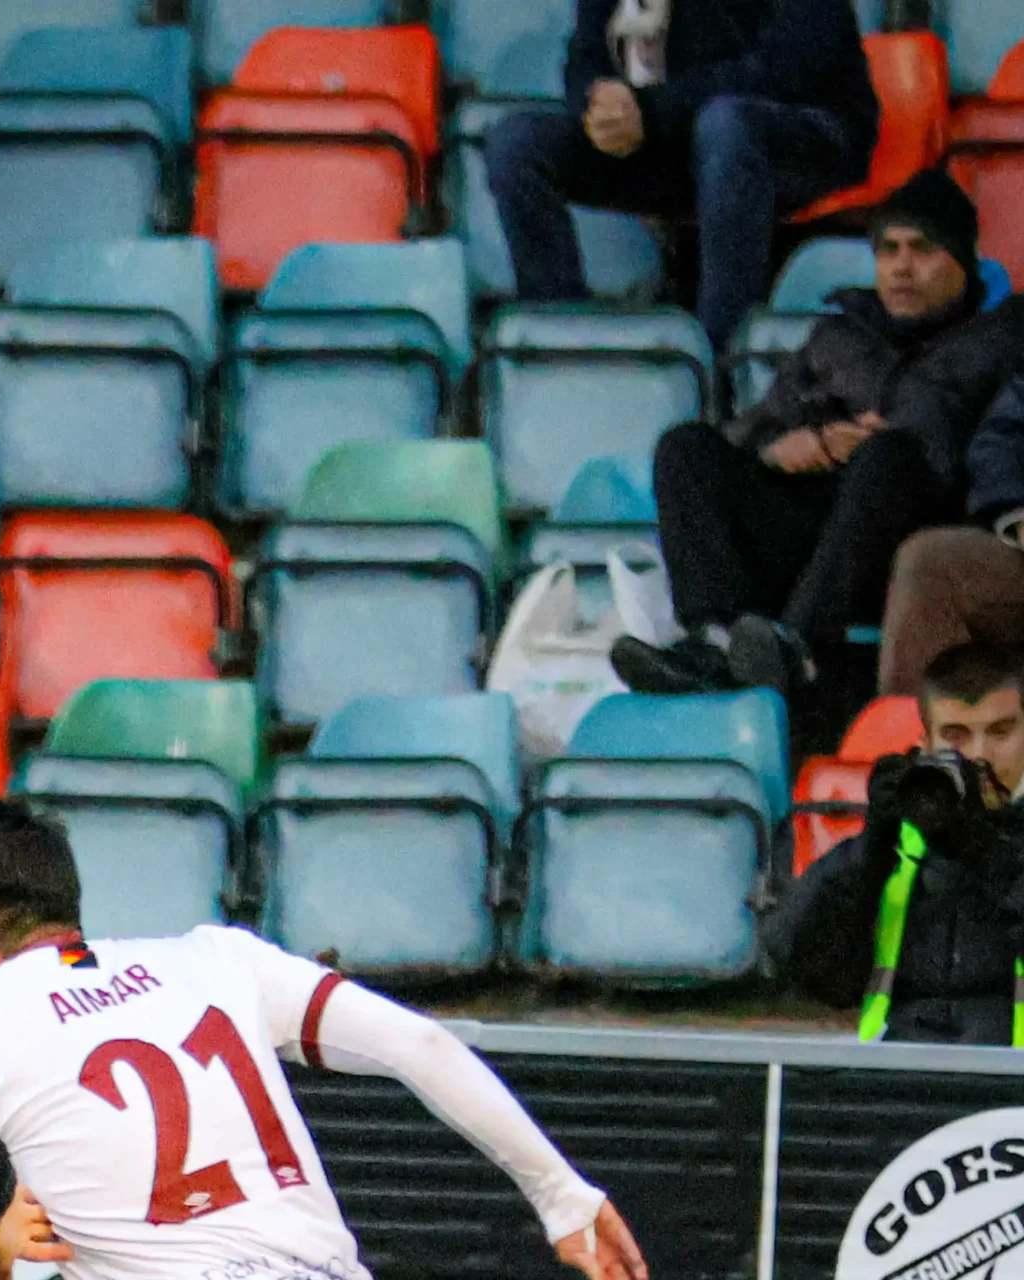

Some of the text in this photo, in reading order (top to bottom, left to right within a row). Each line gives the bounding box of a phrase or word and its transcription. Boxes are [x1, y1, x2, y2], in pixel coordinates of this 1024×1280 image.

[48, 963, 163, 1024] AIMAR
[79, 1004, 310, 1226] 21
[865, 1138, 1024, 1257] GOES
